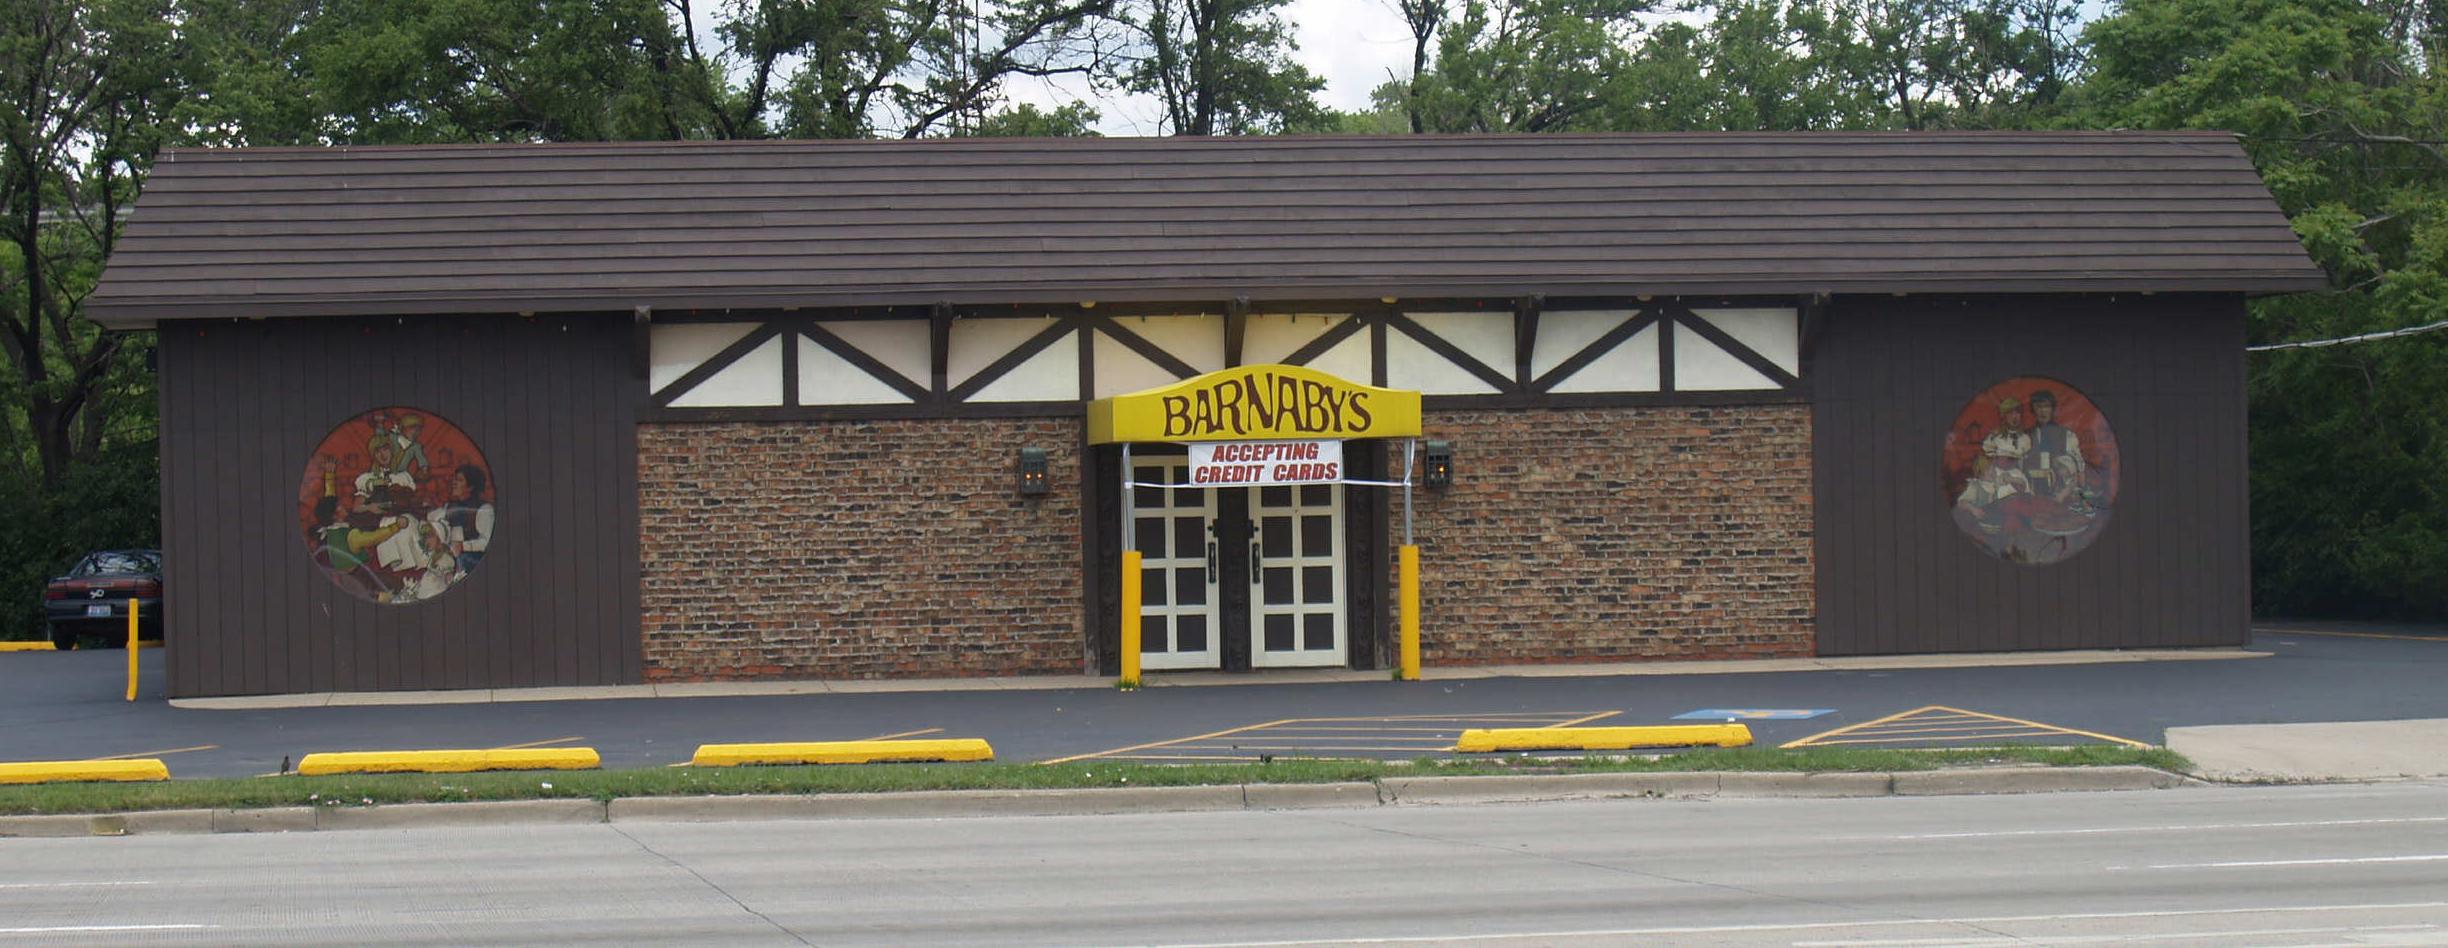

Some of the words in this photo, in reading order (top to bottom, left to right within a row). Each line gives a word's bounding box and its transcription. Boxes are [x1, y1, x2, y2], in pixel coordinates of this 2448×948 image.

[1163, 373, 1372, 436] BARNABY'S
[1212, 443, 1319, 462] ACCEPTING
[1195, 464, 1264, 483] CREDIT
[1273, 462, 1338, 480] CARDS
